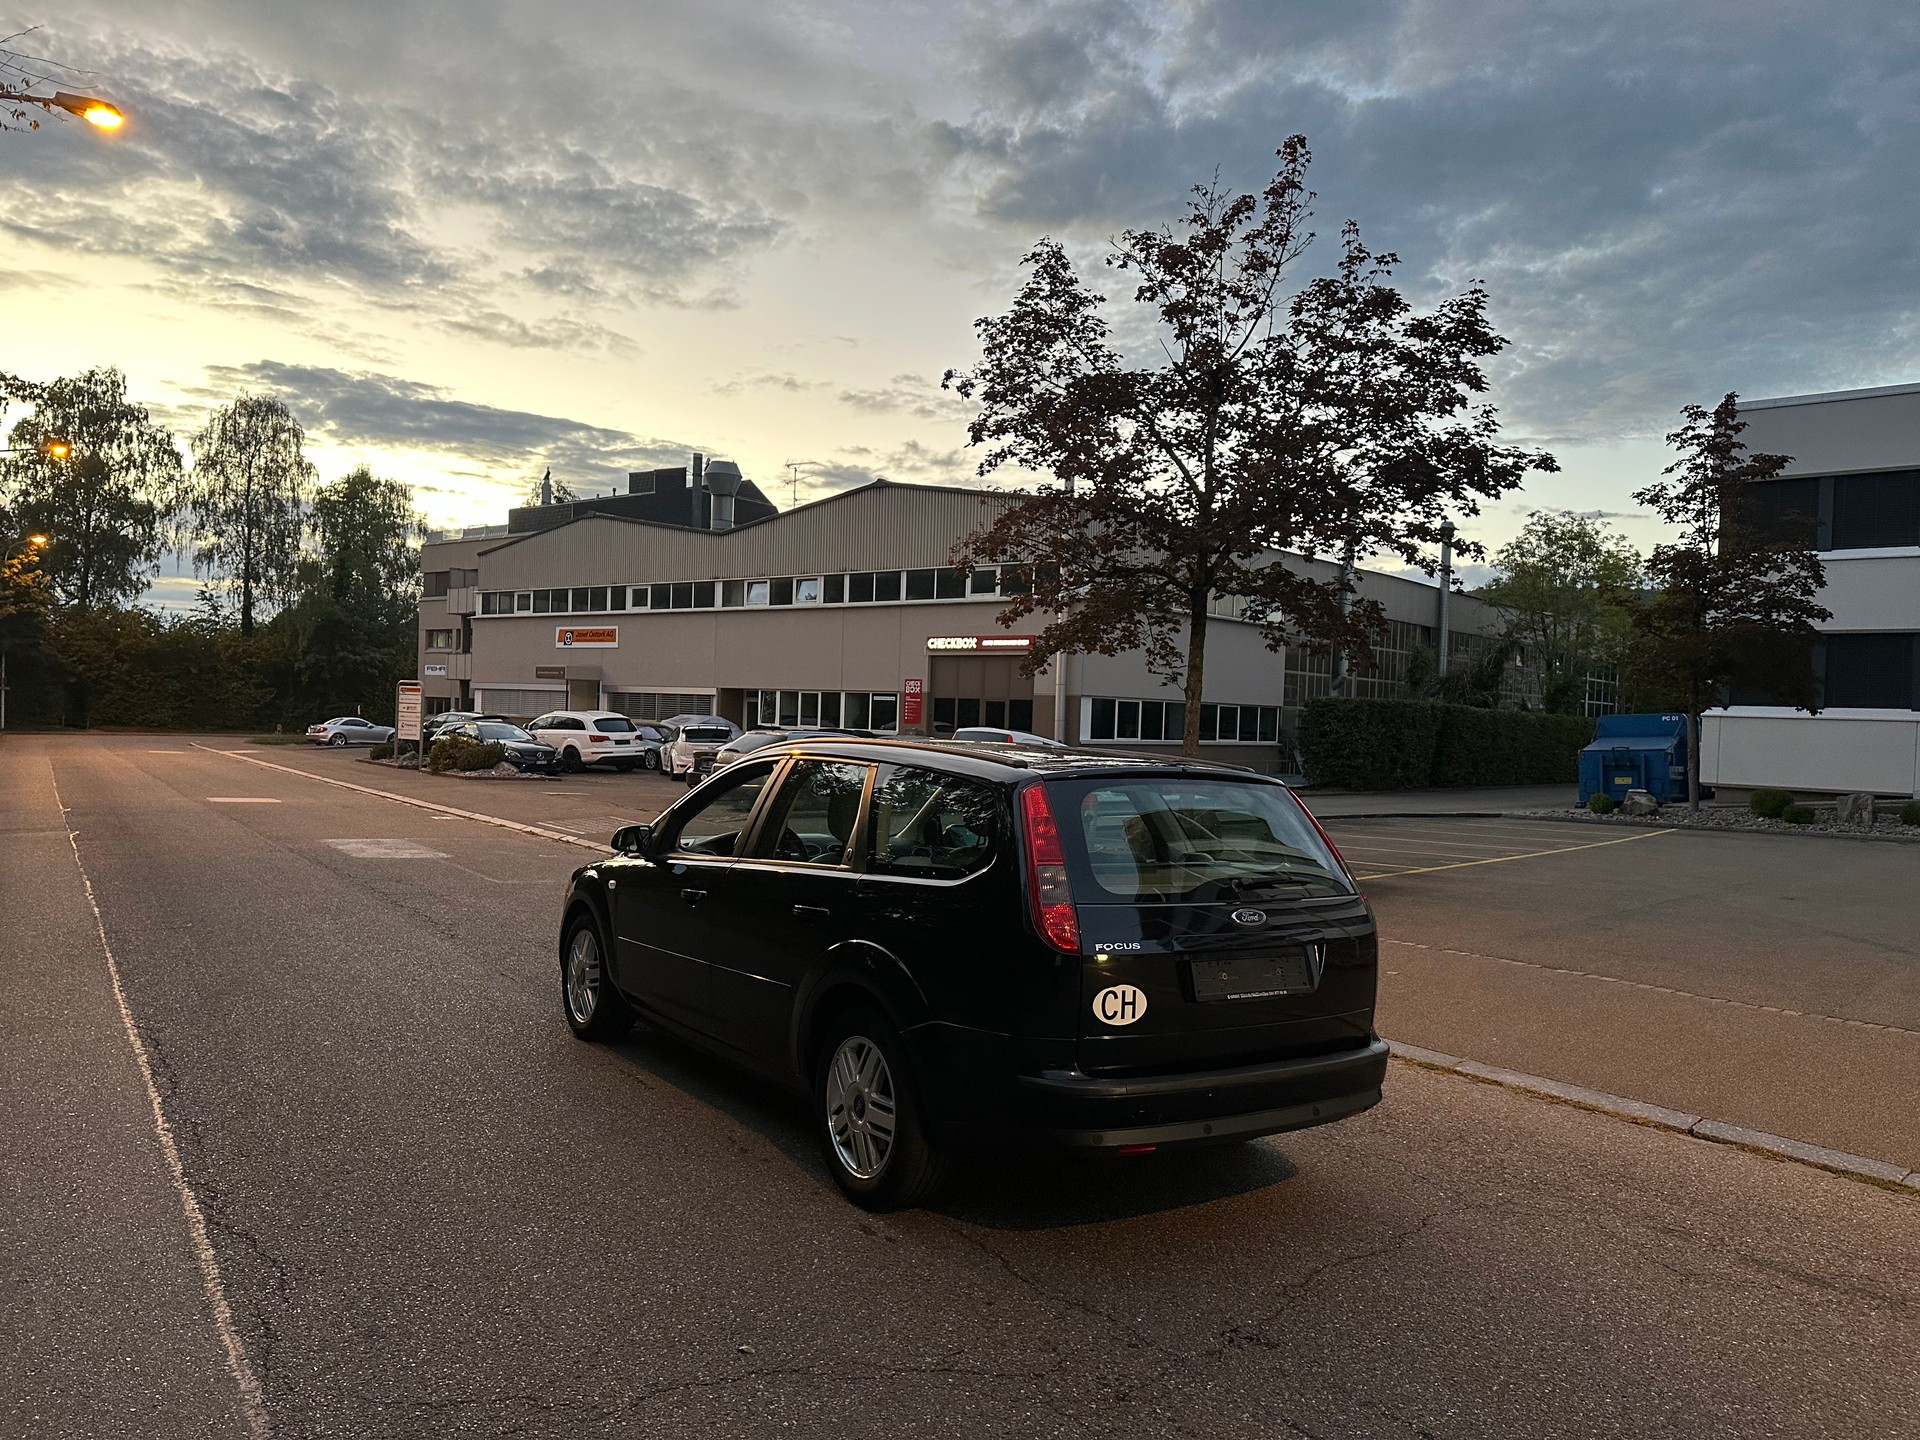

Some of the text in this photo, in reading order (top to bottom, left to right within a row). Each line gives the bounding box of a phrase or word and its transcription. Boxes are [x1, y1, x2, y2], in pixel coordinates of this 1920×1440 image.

[606, 630, 614, 638] AG
[927, 637, 977, 649] CHECKBOX
[1241, 911, 1259, 922] Ford
[1095, 943, 1141, 952] FOCUS
[1101, 990, 1137, 1021] CH
